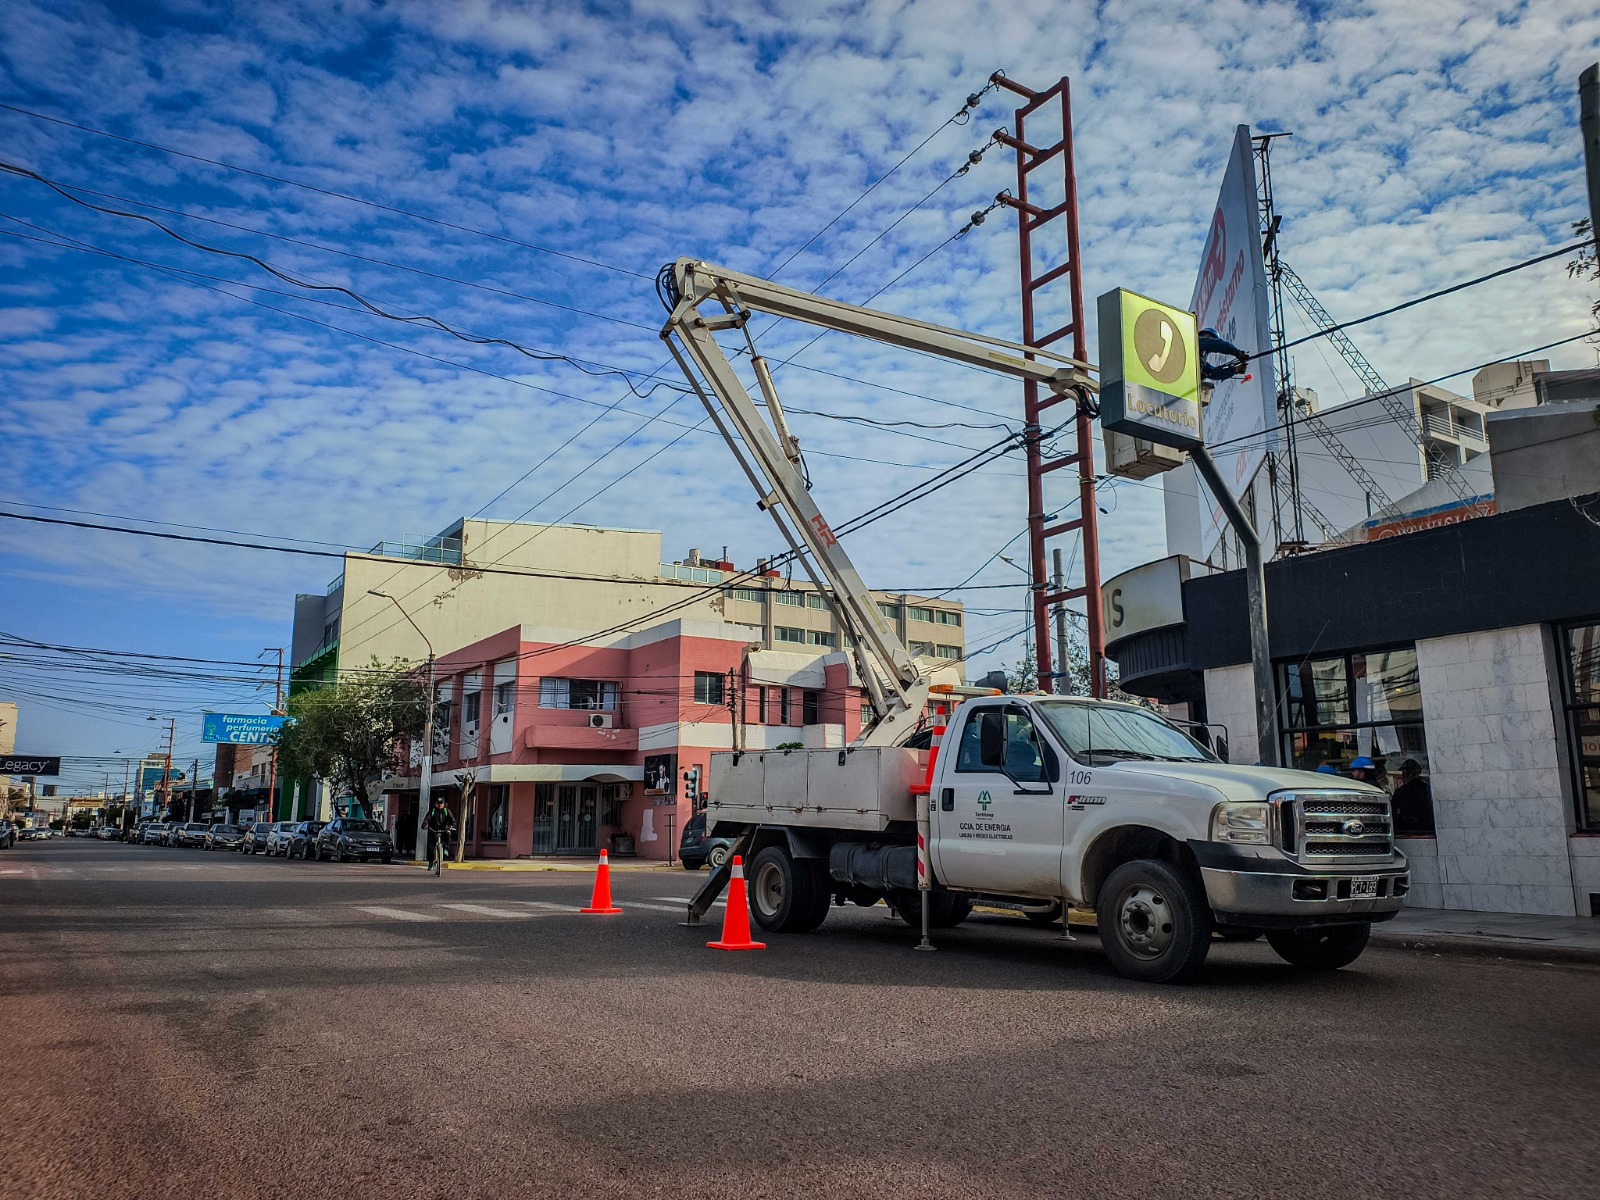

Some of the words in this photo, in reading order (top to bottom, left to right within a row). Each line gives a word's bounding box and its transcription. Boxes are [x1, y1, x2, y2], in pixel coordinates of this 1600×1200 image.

[1127, 393, 1197, 429] Locutorio
[222, 714, 268, 725] farmacia
[1070, 770, 1092, 785] 106
[976, 823, 984, 831] DE
[984, 823, 1012, 832] ENERGIA
[1350, 824, 1363, 834] Ford
